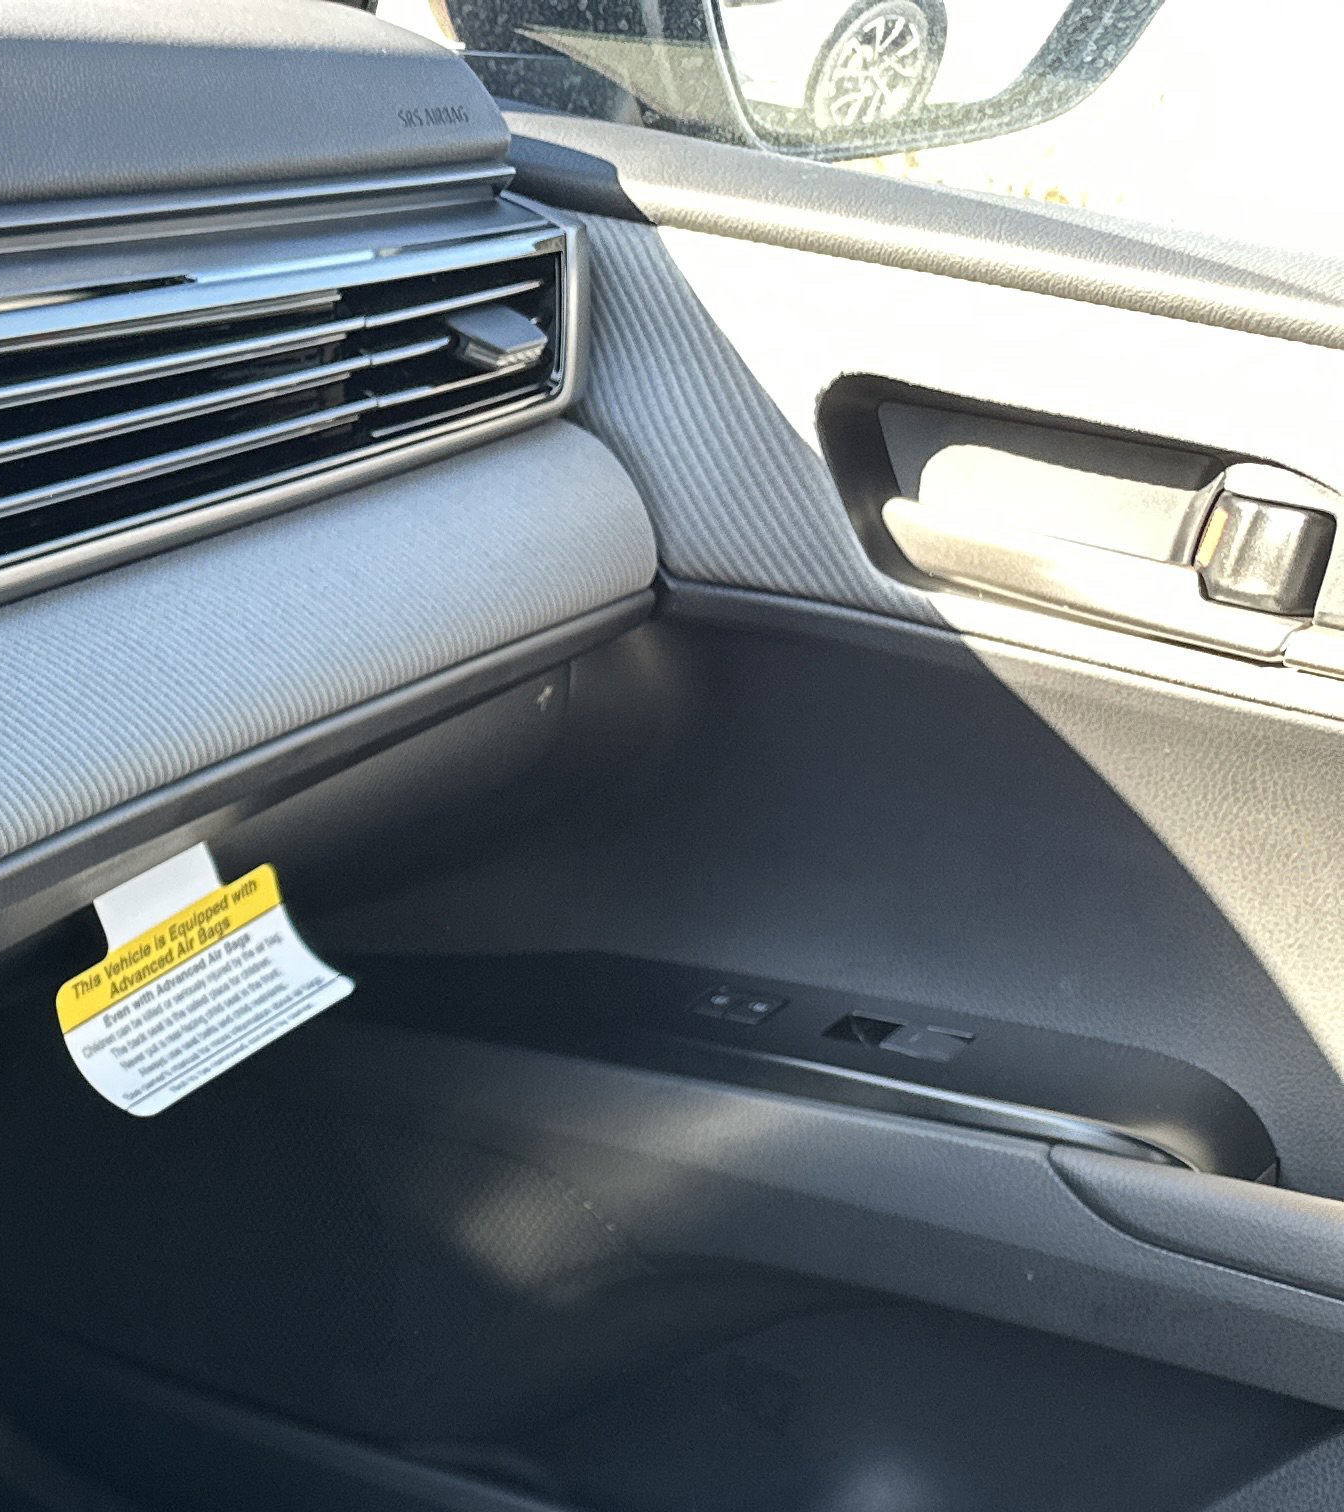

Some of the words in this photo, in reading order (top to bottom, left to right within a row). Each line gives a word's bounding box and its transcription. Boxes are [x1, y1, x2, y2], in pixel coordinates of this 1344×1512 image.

[70, 973, 102, 1001] This
[103, 943, 152, 980] Vehicle
[168, 895, 230, 942] Equipped
[230, 878, 259, 906] with
[102, 1005, 132, 1029] Even
[133, 989, 156, 1012] with
[155, 957, 208, 996] Advanced
[208, 949, 223, 967] Air
[224, 932, 252, 958] Bags
[109, 949, 175, 999] Advanced
[176, 932, 196, 953] Air
[197, 916, 231, 946] Bags
